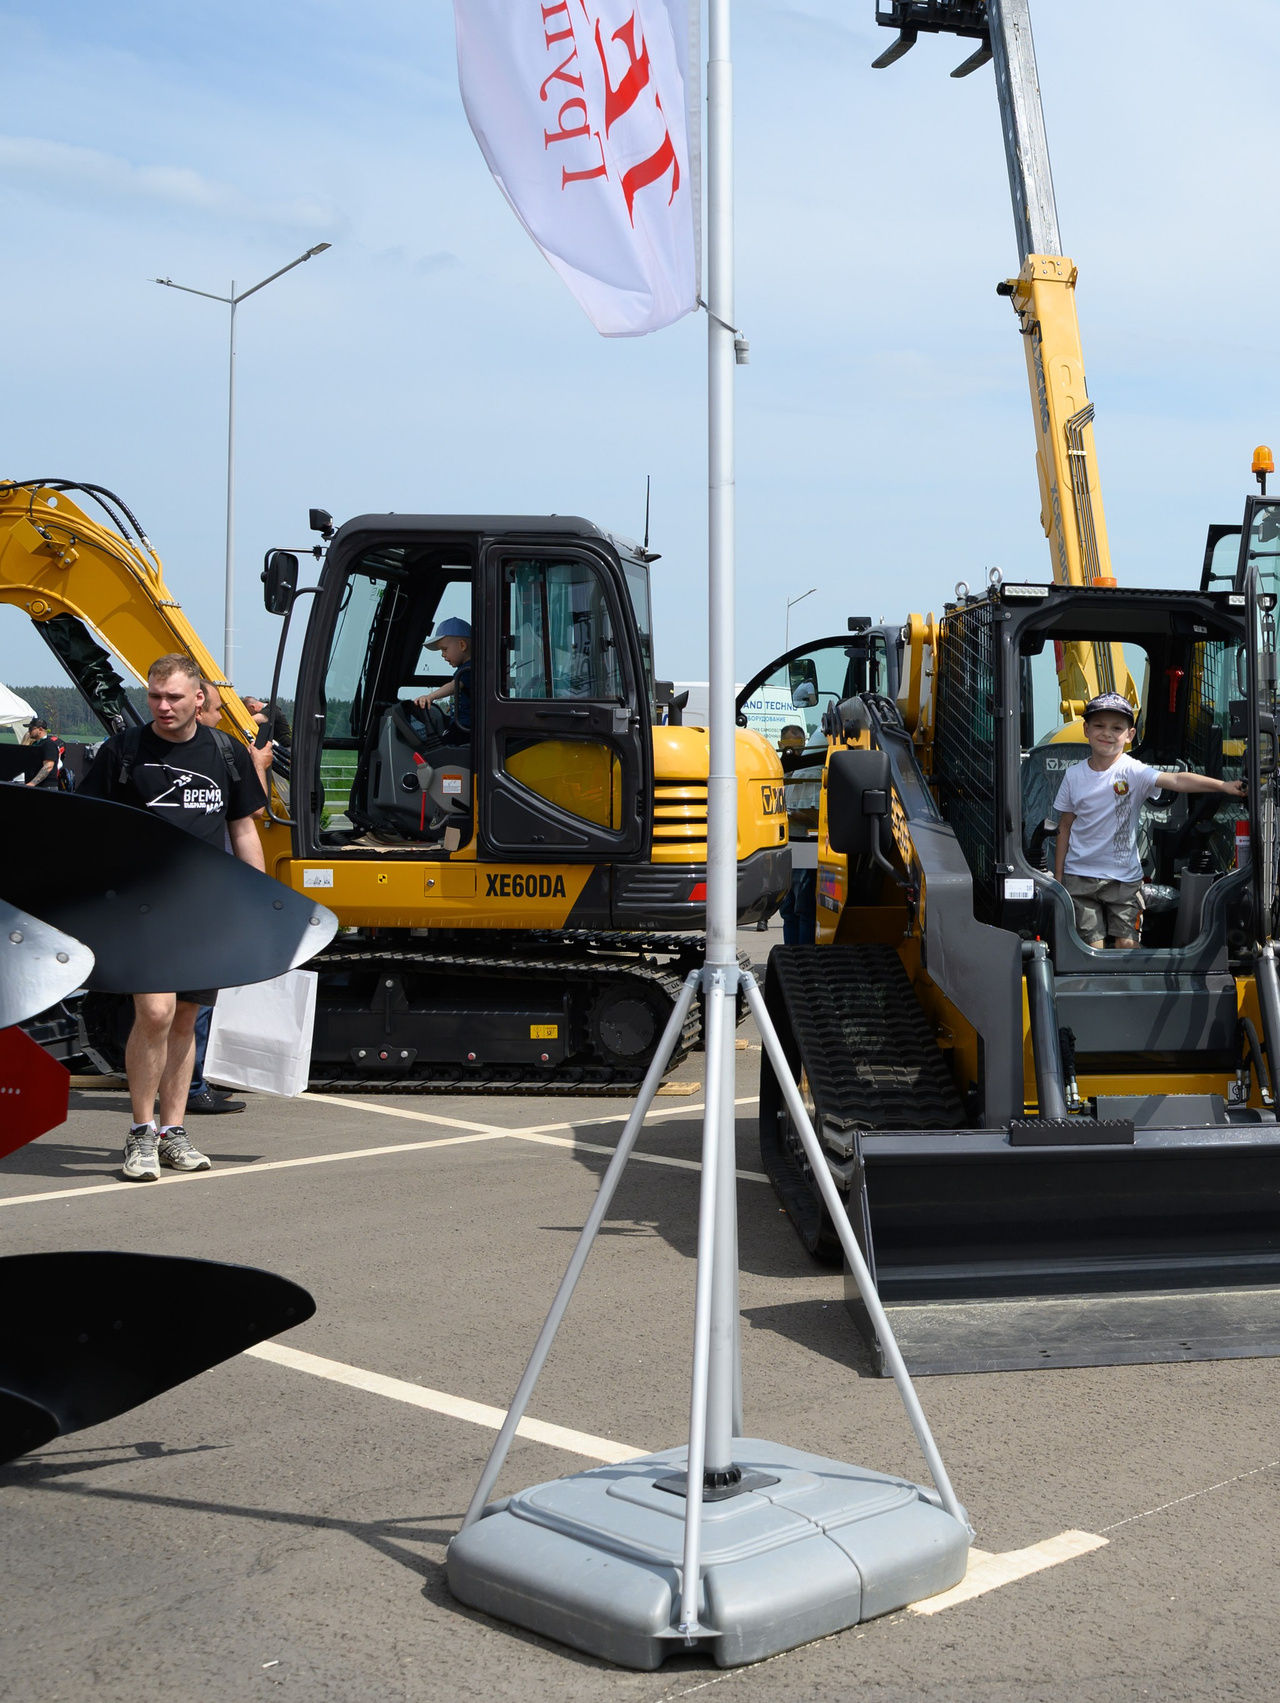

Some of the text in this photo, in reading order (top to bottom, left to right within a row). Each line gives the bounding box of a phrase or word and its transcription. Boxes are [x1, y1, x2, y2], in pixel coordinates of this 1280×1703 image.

[1050, 480, 1070, 585] XC6-300
[743, 701, 762, 709] AND
[747, 715, 786, 723] БОРУДОВАНИЕ
[183, 789, 221, 802] ВРЕМЯ
[485, 873, 567, 898] XE60DA
